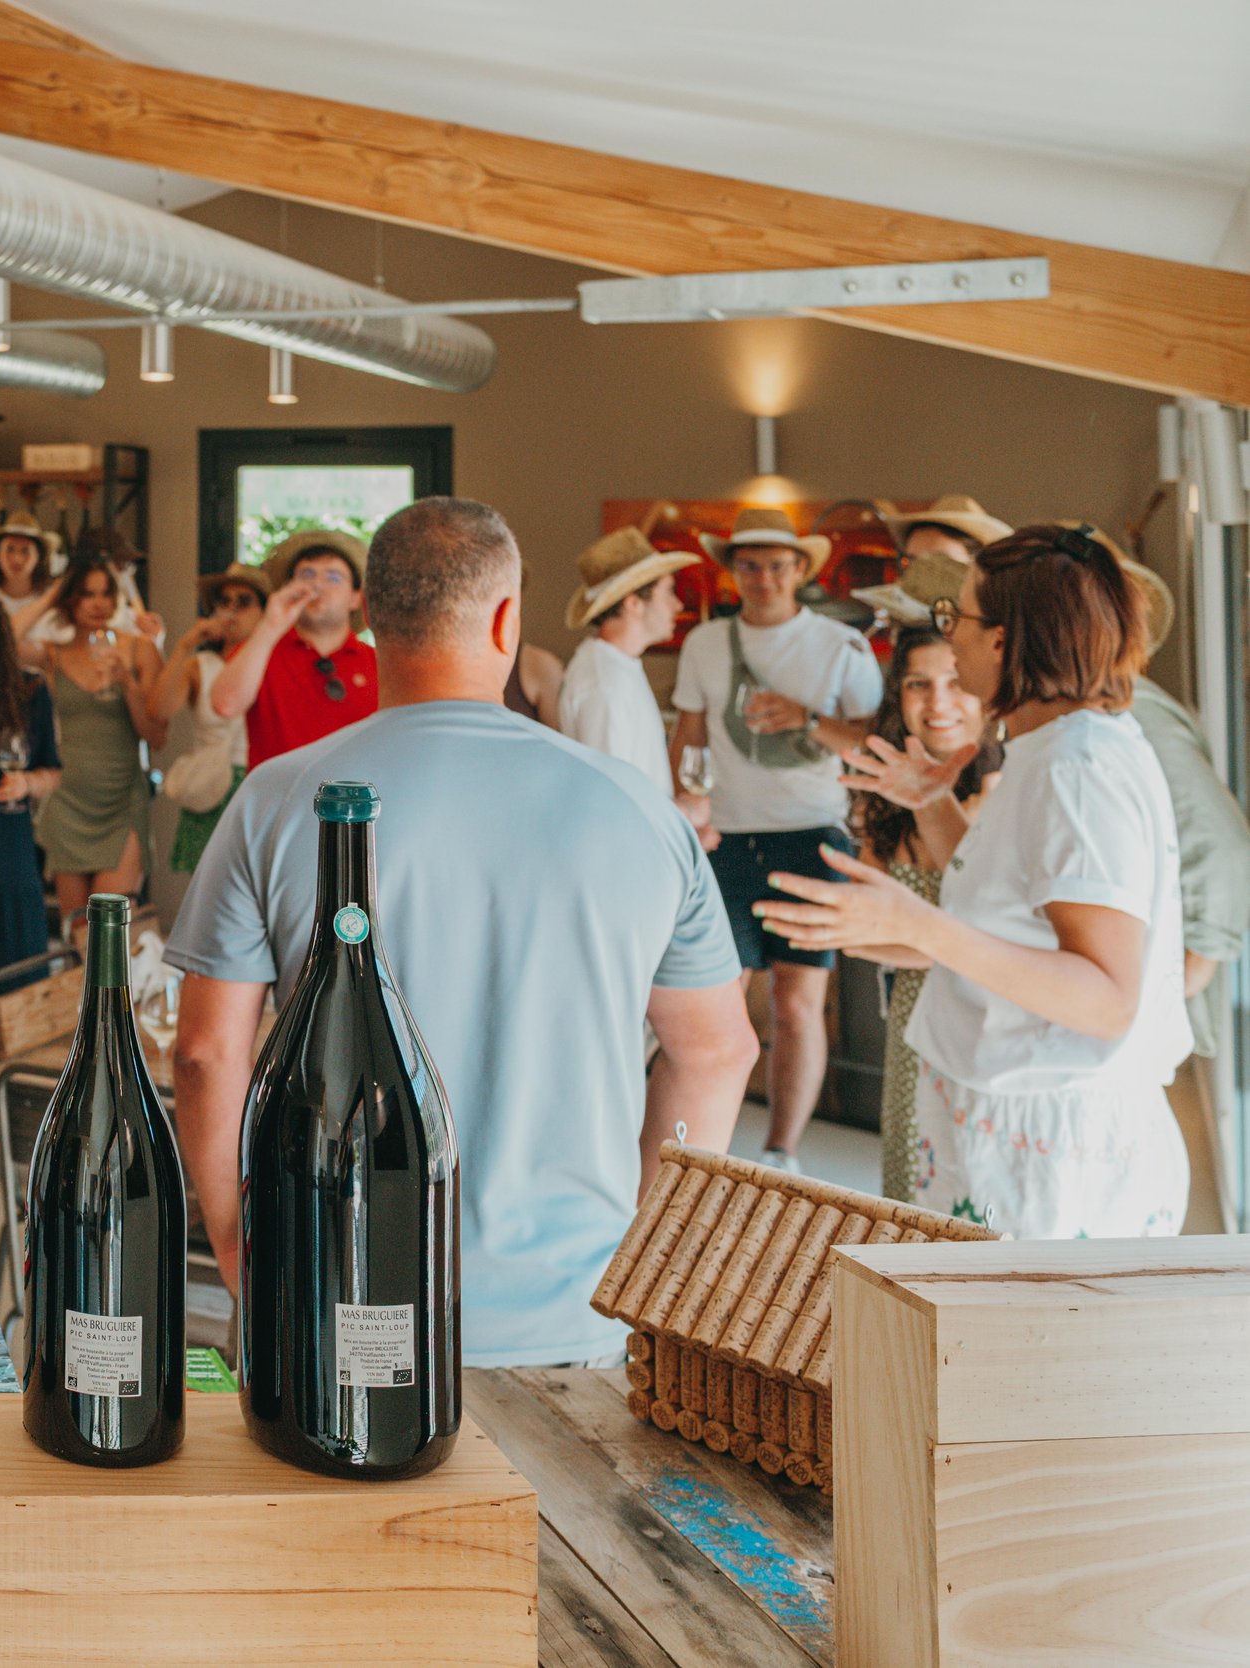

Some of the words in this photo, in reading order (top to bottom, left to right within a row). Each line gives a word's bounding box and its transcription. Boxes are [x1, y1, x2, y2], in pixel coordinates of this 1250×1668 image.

[342, 1310, 359, 1320] MAS
[363, 1310, 408, 1320] BRUGUIERE
[71, 1316, 87, 1328] MAS
[90, 1320, 136, 1331] BRUGUIERE
[87, 1333, 137, 1342] SAINT-LOUP
